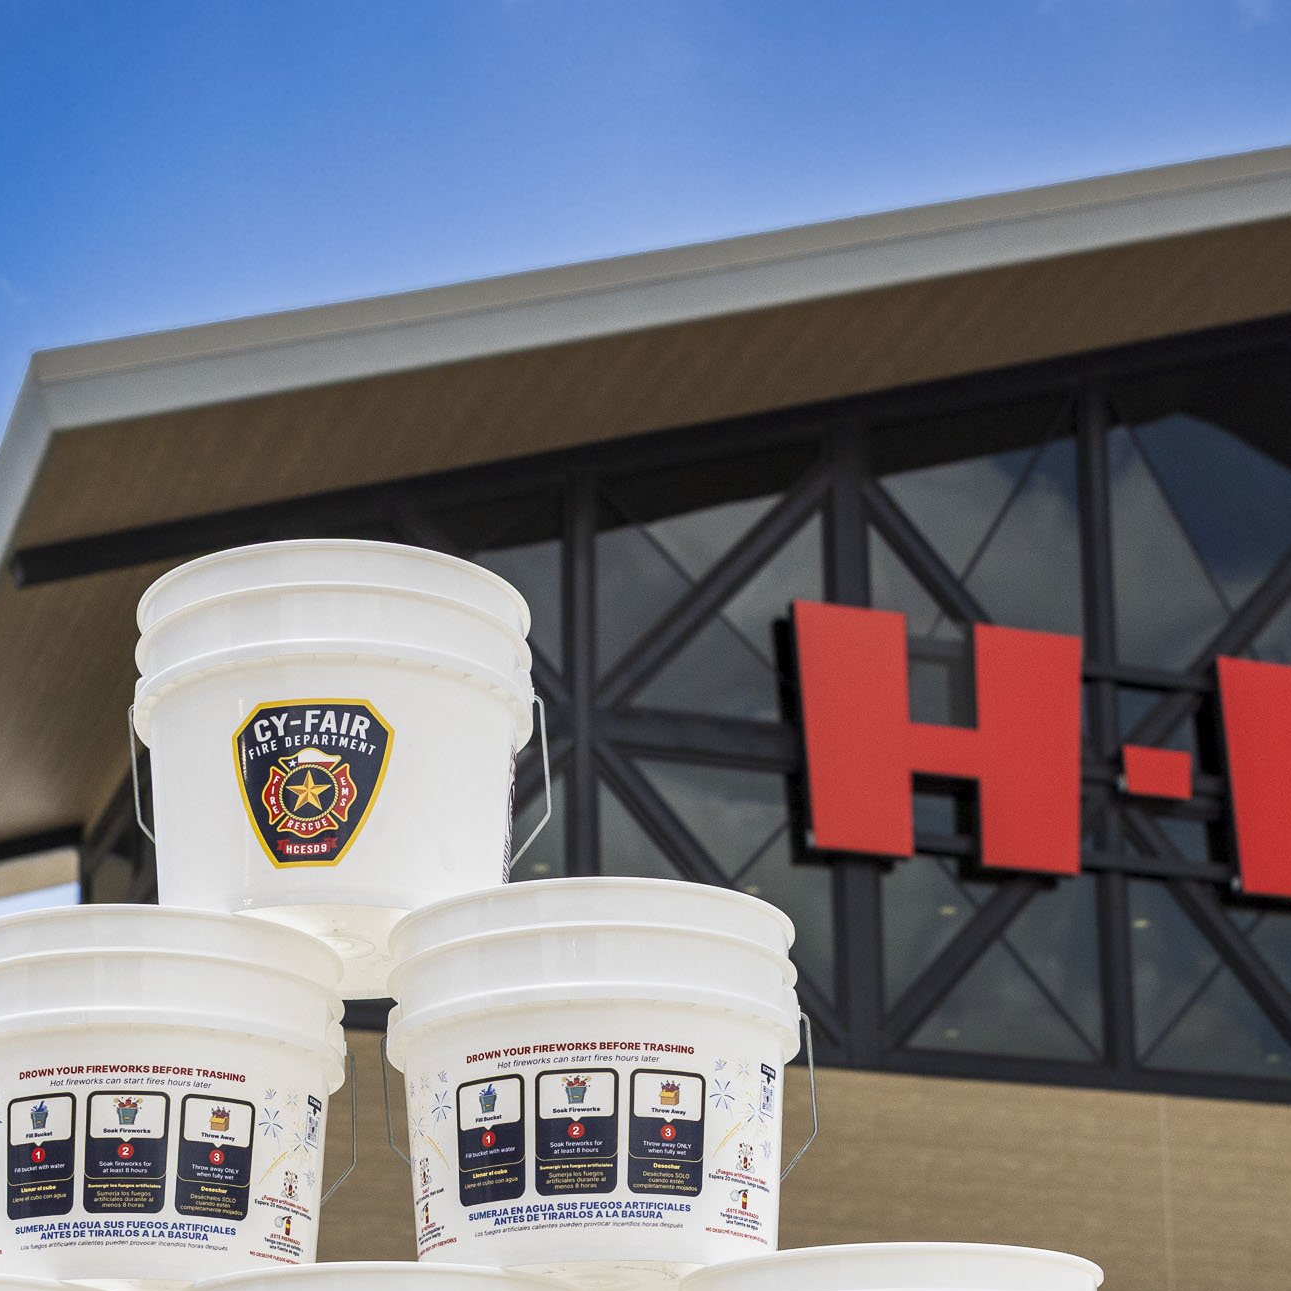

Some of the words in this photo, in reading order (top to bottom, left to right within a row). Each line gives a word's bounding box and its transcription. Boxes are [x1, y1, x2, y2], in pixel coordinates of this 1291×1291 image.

[254, 709, 371, 743] CY-FAIR
[249, 739, 278, 760] FIRE
[286, 735, 376, 756] DEPARTMENT
[270, 776, 281, 815] FIRE
[340, 777, 349, 807] EMS
[286, 818, 328, 831] RESCUE
[286, 844, 327, 854] HCESD9
[467, 1050, 501, 1064] DROWN
[503, 1046, 531, 1056] YOUR
[533, 1042, 597, 1053] FIREWORKS
[599, 1042, 641, 1050] BEFORE
[643, 1043, 694, 1054] TRASHING
[497, 1061, 511, 1069] Hot
[514, 1058, 550, 1067] fireworks
[20, 1068, 54, 1080] DROWN
[56, 1066, 84, 1075] YOUR
[86, 1065, 150, 1073] FIREWORKS
[152, 1066, 193, 1075] BEFORE
[196, 1069, 245, 1082] TRASHING
[573, 1126, 579, 1135] 2
[665, 1128, 671, 1137] 3
[486, 1135, 490, 1143] 1
[36, 1151, 40, 1159] 1
[122, 1147, 129, 1155] 2
[214, 1153, 220, 1161] 3
[469, 1208, 510, 1222] SUMERJA
[511, 1206, 523, 1215] EN
[525, 1204, 554, 1213] AGUA
[557, 1202, 577, 1210] SUS
[580, 1202, 622, 1210] FUEGOS
[625, 1202, 691, 1212] ARTIFICIALES
[494, 1215, 525, 1226] ANTES
[527, 1214, 539, 1222] DE
[542, 1211, 593, 1220] TIRARLOS
[596, 1210, 603, 1218] A
[622, 1210, 662, 1219] BASURA
[15, 1224, 56, 1234] SUMERJA
[58, 1222, 70, 1230] EN
[72, 1221, 101, 1229] AGUA
[127, 1221, 168, 1229] FUEGOS
[171, 1223, 236, 1236] ARTIFICIALES
[41, 1231, 71, 1240] ANTES
[73, 1230, 85, 1238] DE
[168, 1231, 208, 1241] BASURA
